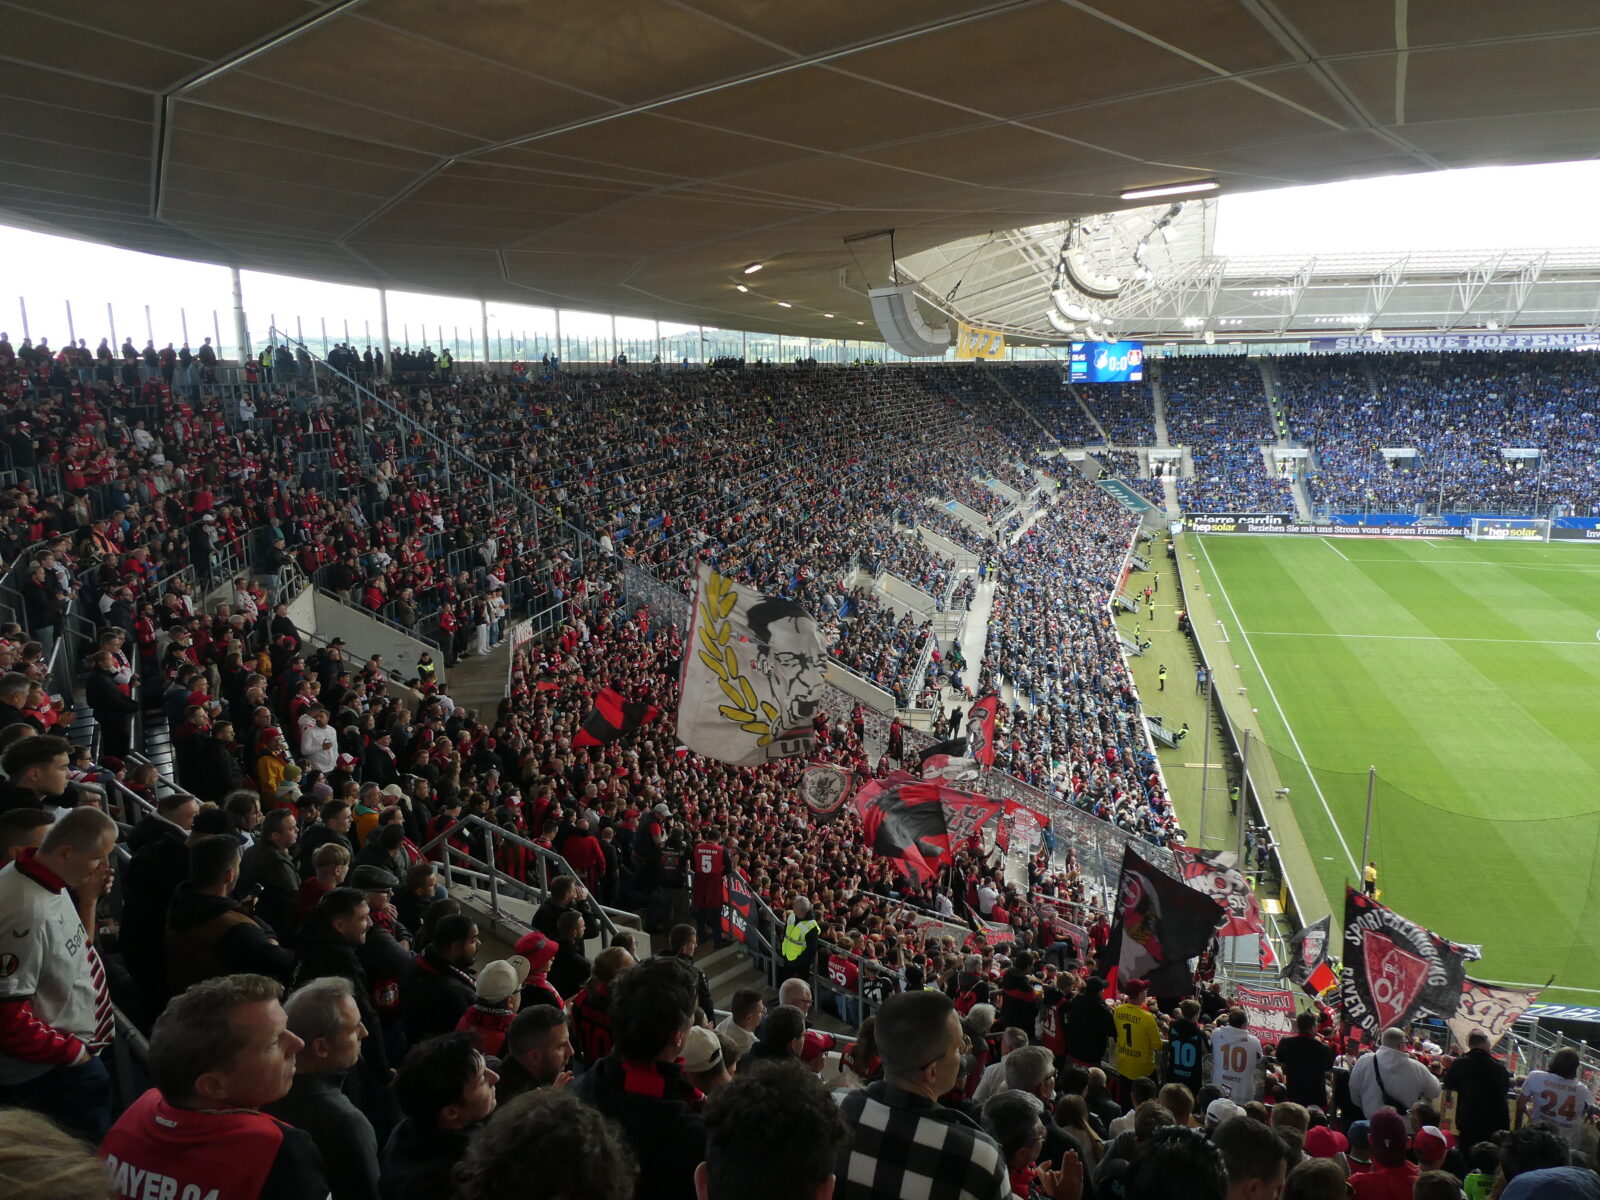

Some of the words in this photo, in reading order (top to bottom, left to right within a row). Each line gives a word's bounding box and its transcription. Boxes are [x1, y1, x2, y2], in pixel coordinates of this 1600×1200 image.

[1194, 514, 1235, 523] pierre
[1238, 514, 1282, 524] cardin
[1248, 524, 1285, 532] Beziehen
[1286, 524, 1300, 532] Sie
[1301, 525, 1316, 533] mit
[1334, 526, 1360, 534] Strom
[1382, 527, 1415, 535] eigenen
[701, 855, 712, 873] 5
[1122, 1023, 1132, 1047] 1
[1171, 1040, 1197, 1068] 10
[1220, 1043, 1247, 1073] 10
[1540, 1090, 1576, 1121] 24
